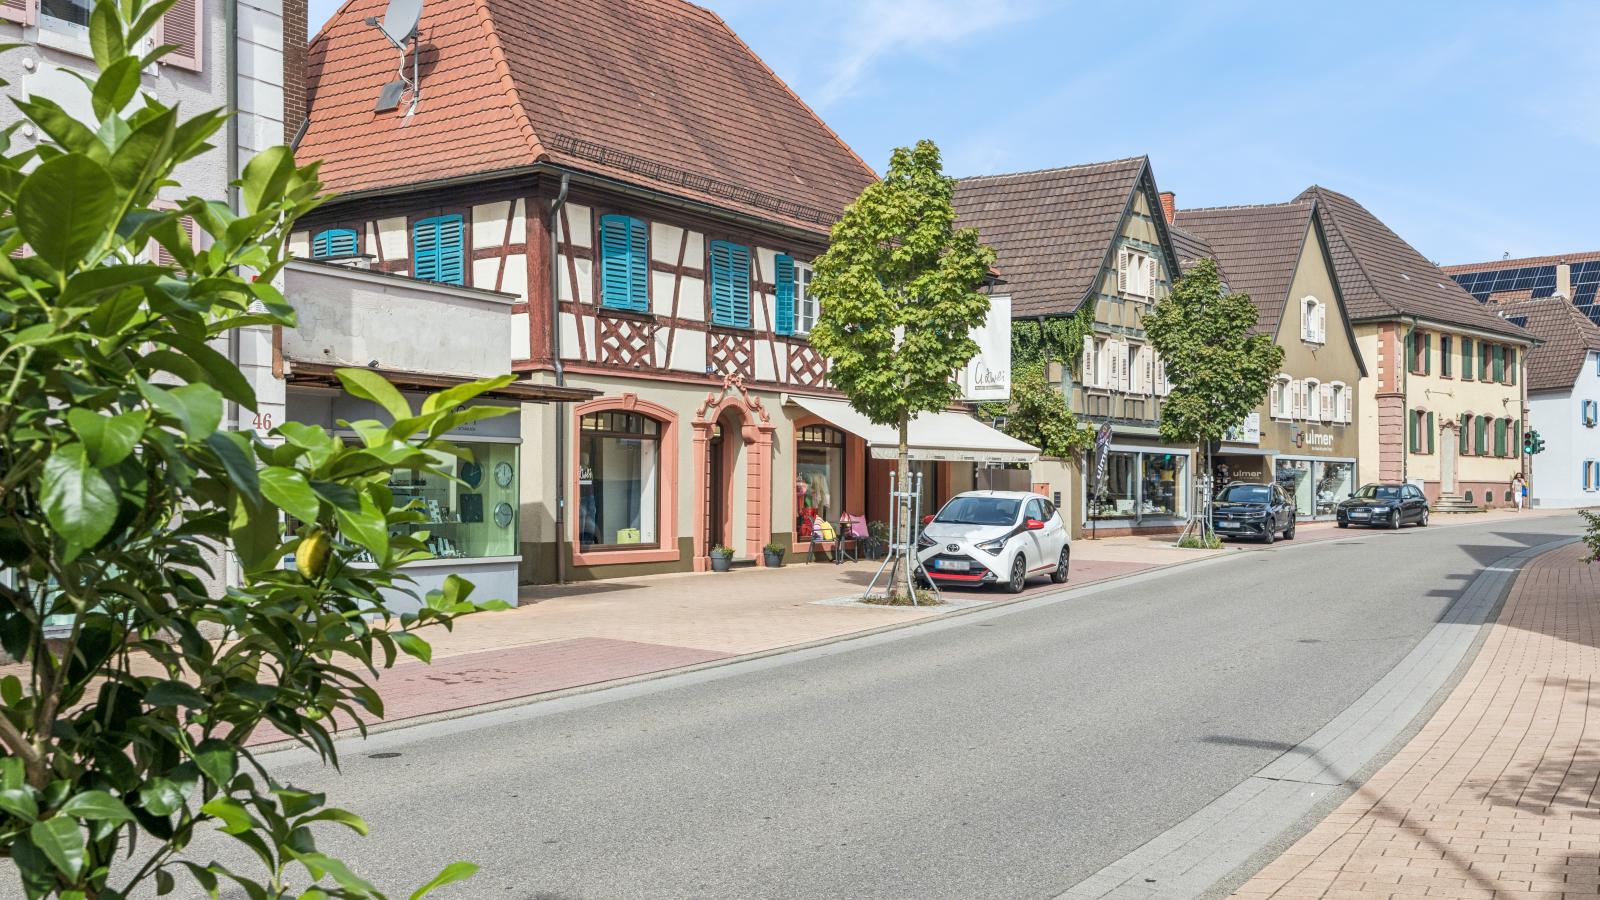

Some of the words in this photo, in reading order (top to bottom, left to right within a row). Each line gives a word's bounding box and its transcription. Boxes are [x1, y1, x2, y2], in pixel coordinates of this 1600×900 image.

[252, 412, 272, 430] 46
[1305, 429, 1334, 446] ulmer
[1232, 469, 1263, 478] ulmer
